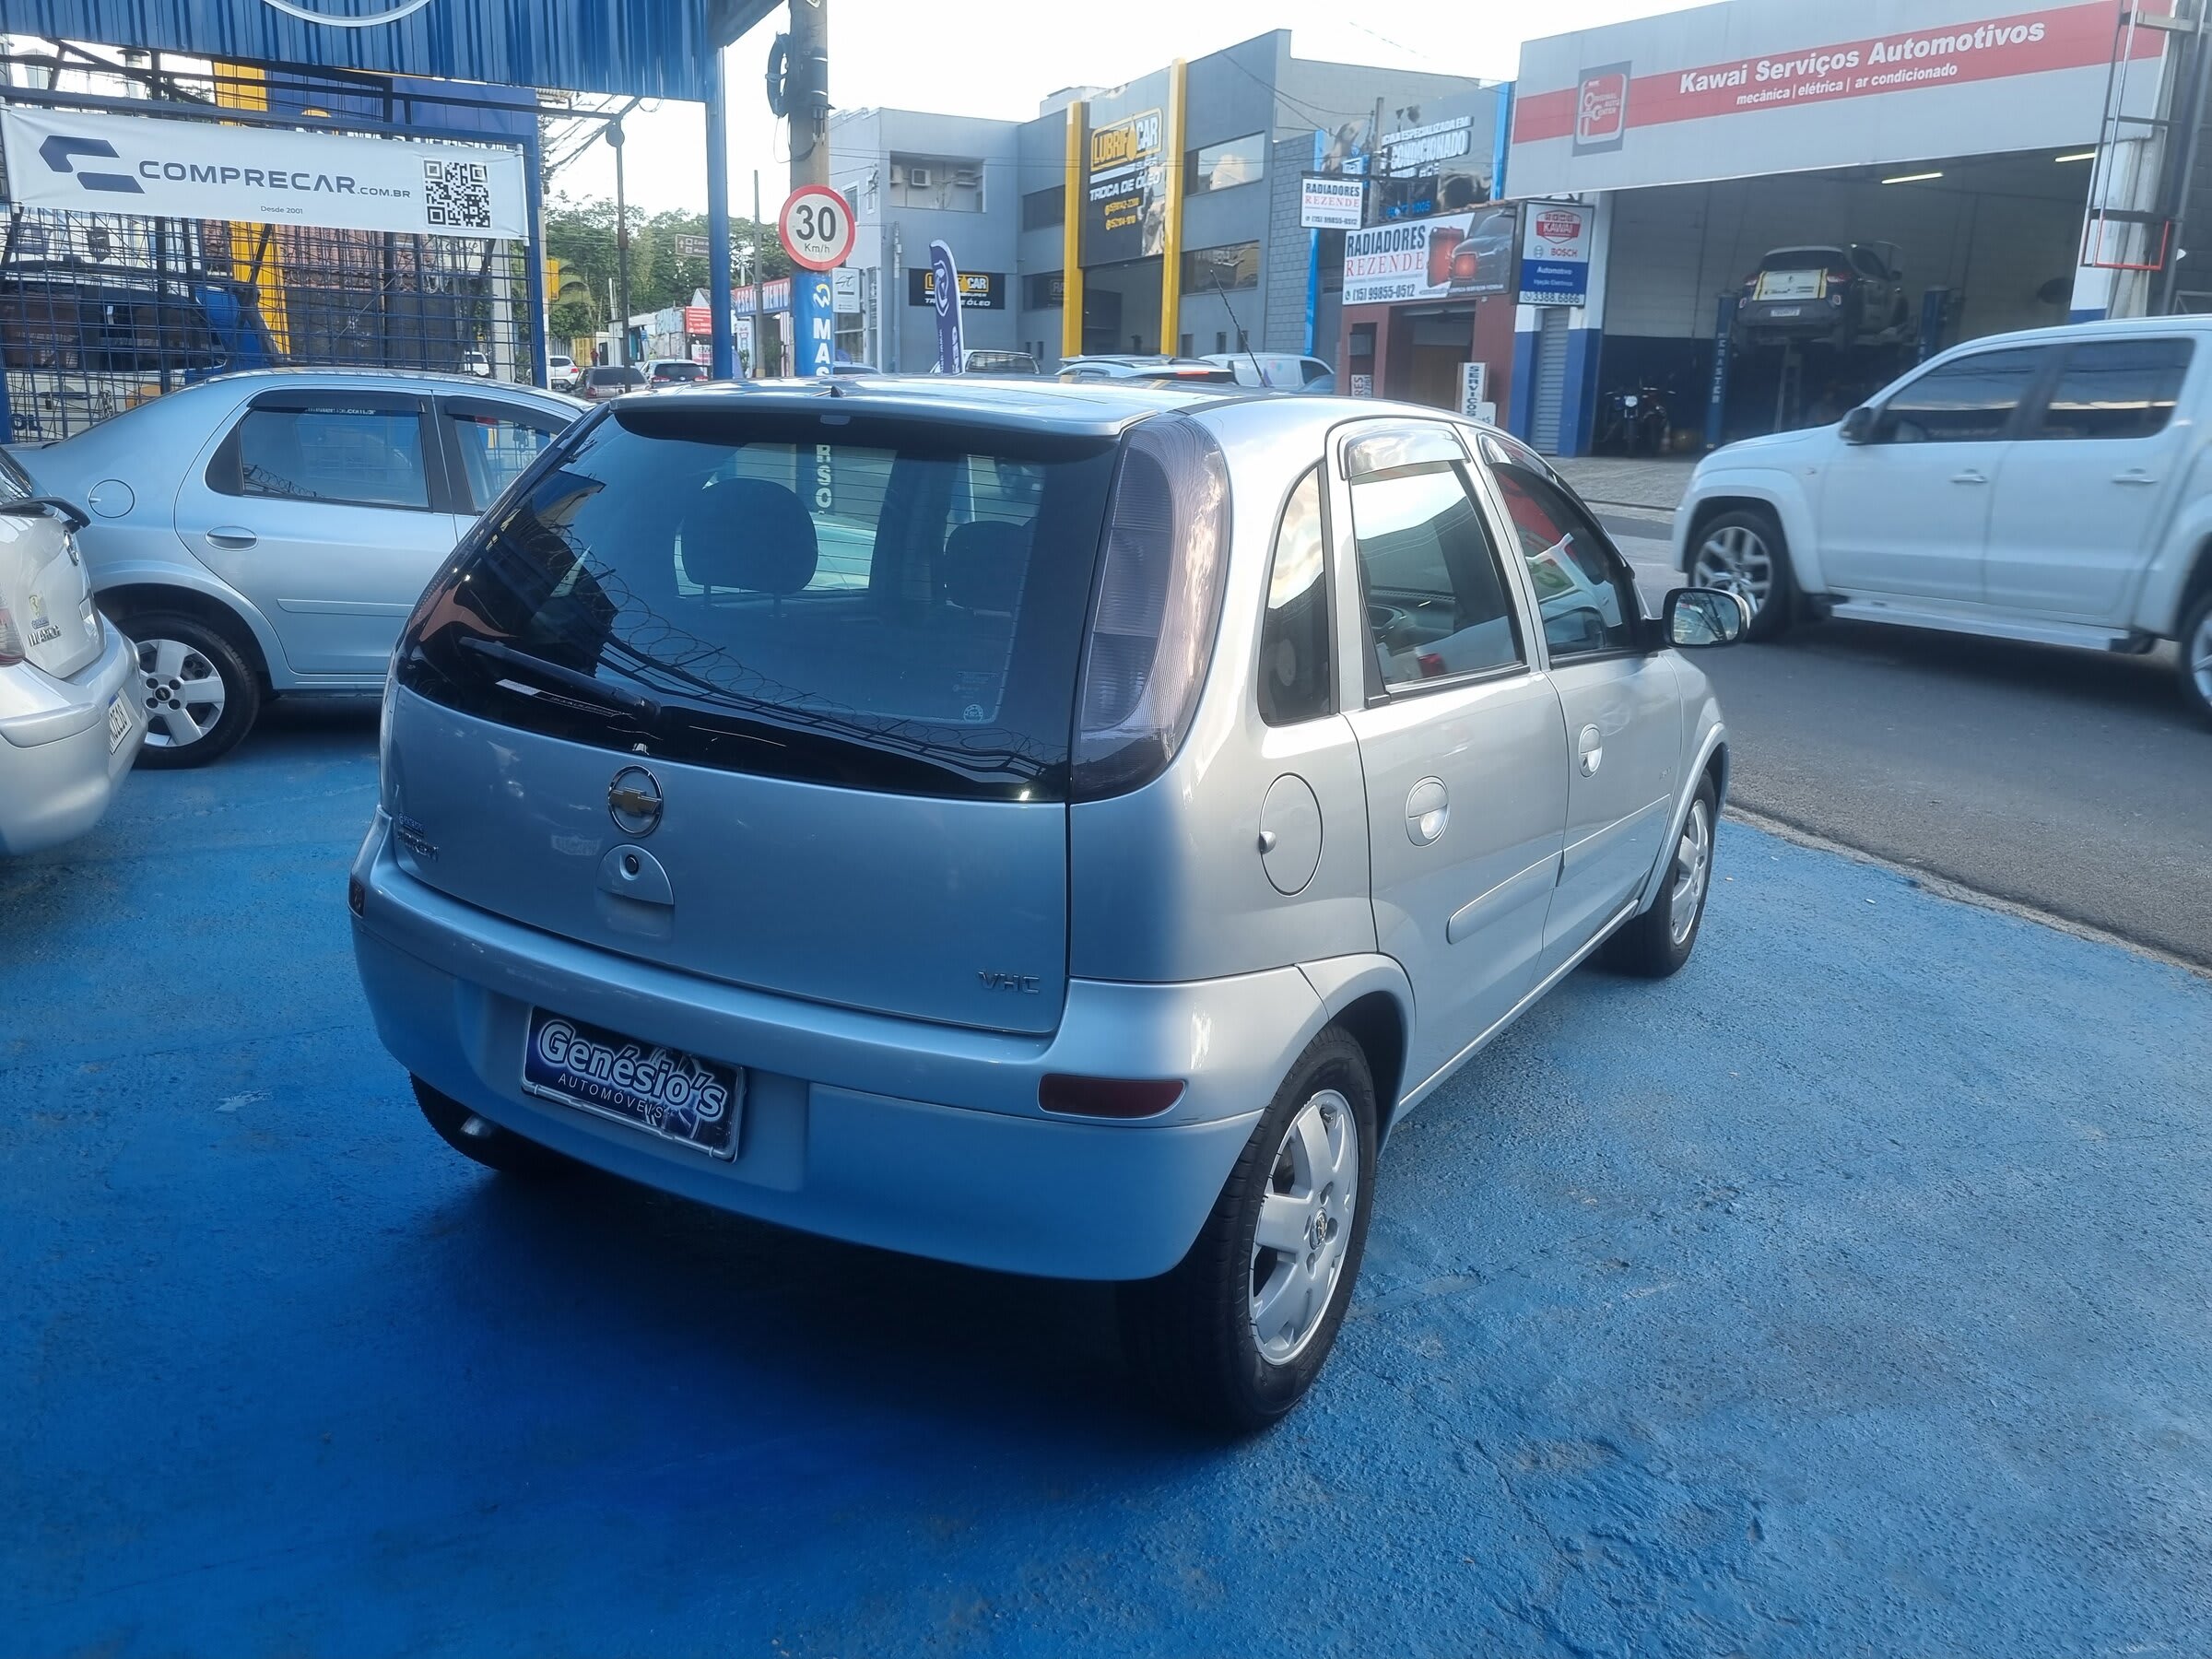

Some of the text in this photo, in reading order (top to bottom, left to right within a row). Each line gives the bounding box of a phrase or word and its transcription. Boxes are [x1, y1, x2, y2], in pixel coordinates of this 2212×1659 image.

[1679, 20, 2045, 94] Kawai Serviços Automotivos
[1736, 63, 1958, 106] mecânica elétrica ar condicionado
[1089, 183, 1120, 202] TROCA
[1120, 178, 1135, 194] DE
[1305, 182, 1360, 197] RADIADORES
[1305, 194, 1360, 207] REZENDE
[260, 205, 303, 215] Desde 2001
[795, 205, 837, 242] 30
[1543, 221, 1573, 234] KAWAI
[805, 243, 830, 253] Km/h
[1347, 225, 1426, 257] RADIADORES
[1550, 248, 1578, 257] BOSCH
[1346, 251, 1424, 276] REZENDE
[968, 277, 986, 289] CAR
[967, 296, 991, 307] ÓLEO
[978, 971, 1040, 994] VHC
[539, 1020, 727, 1122] Genésio's
[558, 1072, 665, 1119] AUTOMÓVEIS
